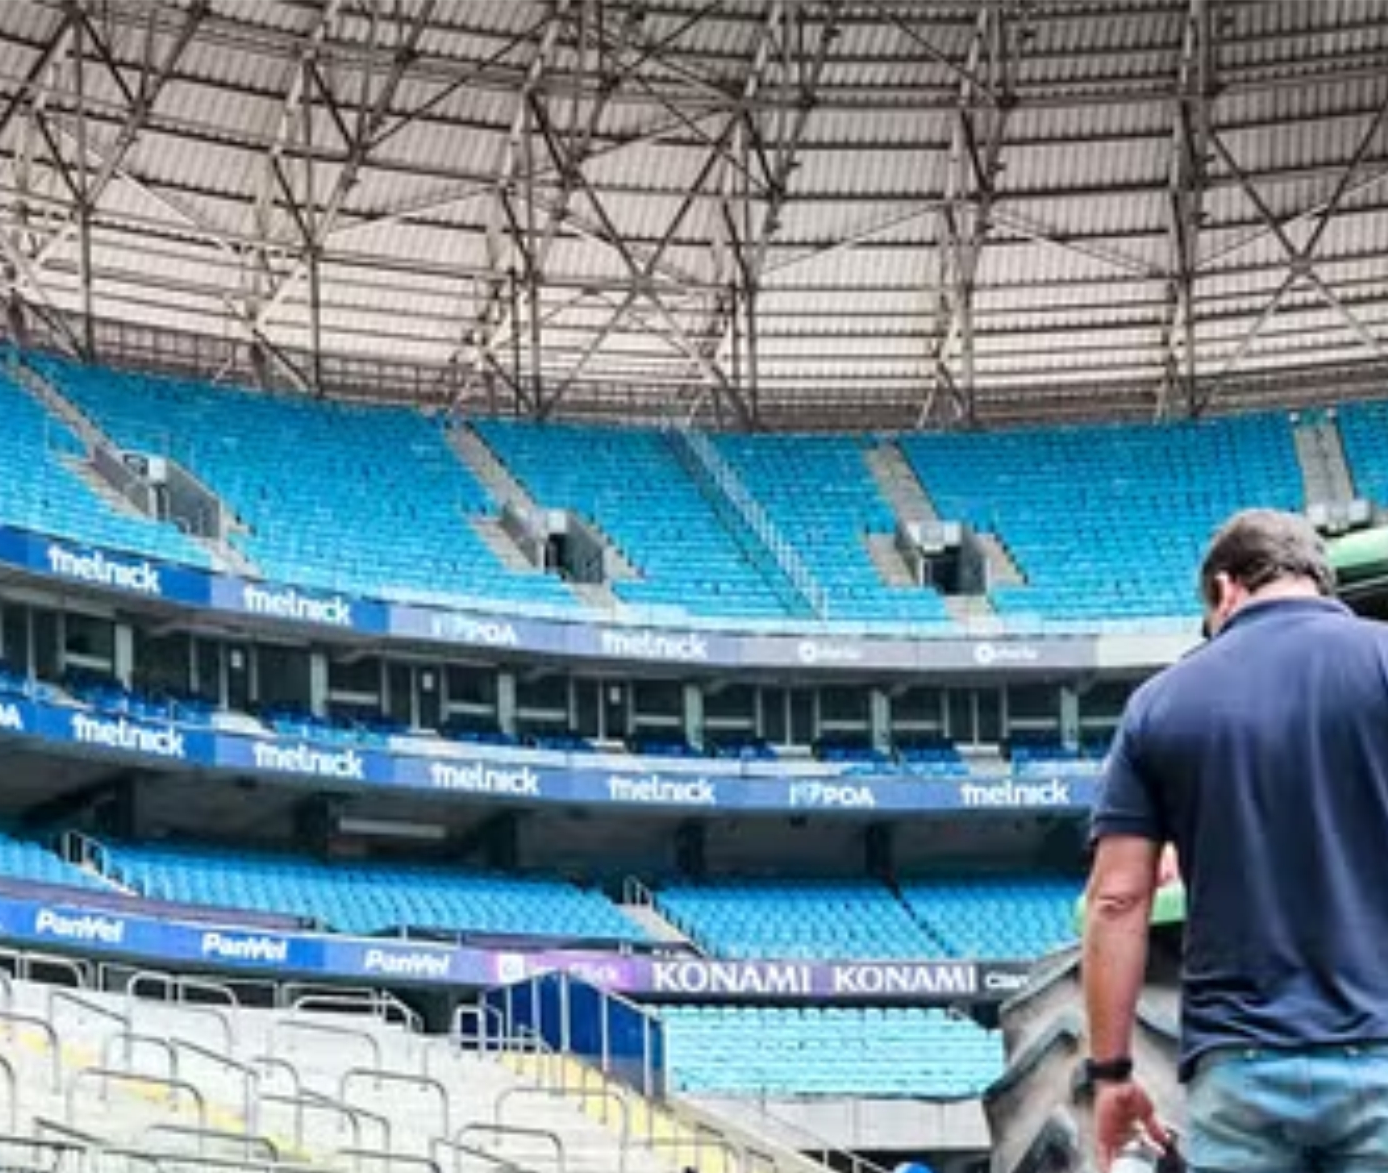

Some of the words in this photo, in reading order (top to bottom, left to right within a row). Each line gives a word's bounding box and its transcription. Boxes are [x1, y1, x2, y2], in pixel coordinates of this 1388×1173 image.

[47, 545, 161, 594] melnick
[243, 584, 352, 626] melnick
[601, 628, 709, 659] melnick
[71, 712, 187, 760] melnick
[252, 741, 365, 780] melnick
[429, 762, 542, 797] melnick
[606, 775, 716, 804] melnick
[961, 777, 1071, 806] melnick
[35, 907, 126, 943] PanVel
[201, 932, 288, 960] PanVel
[364, 949, 451, 977] PanVel
[653, 961, 811, 994] KONAMI
[833, 964, 977, 994] KONAMI
